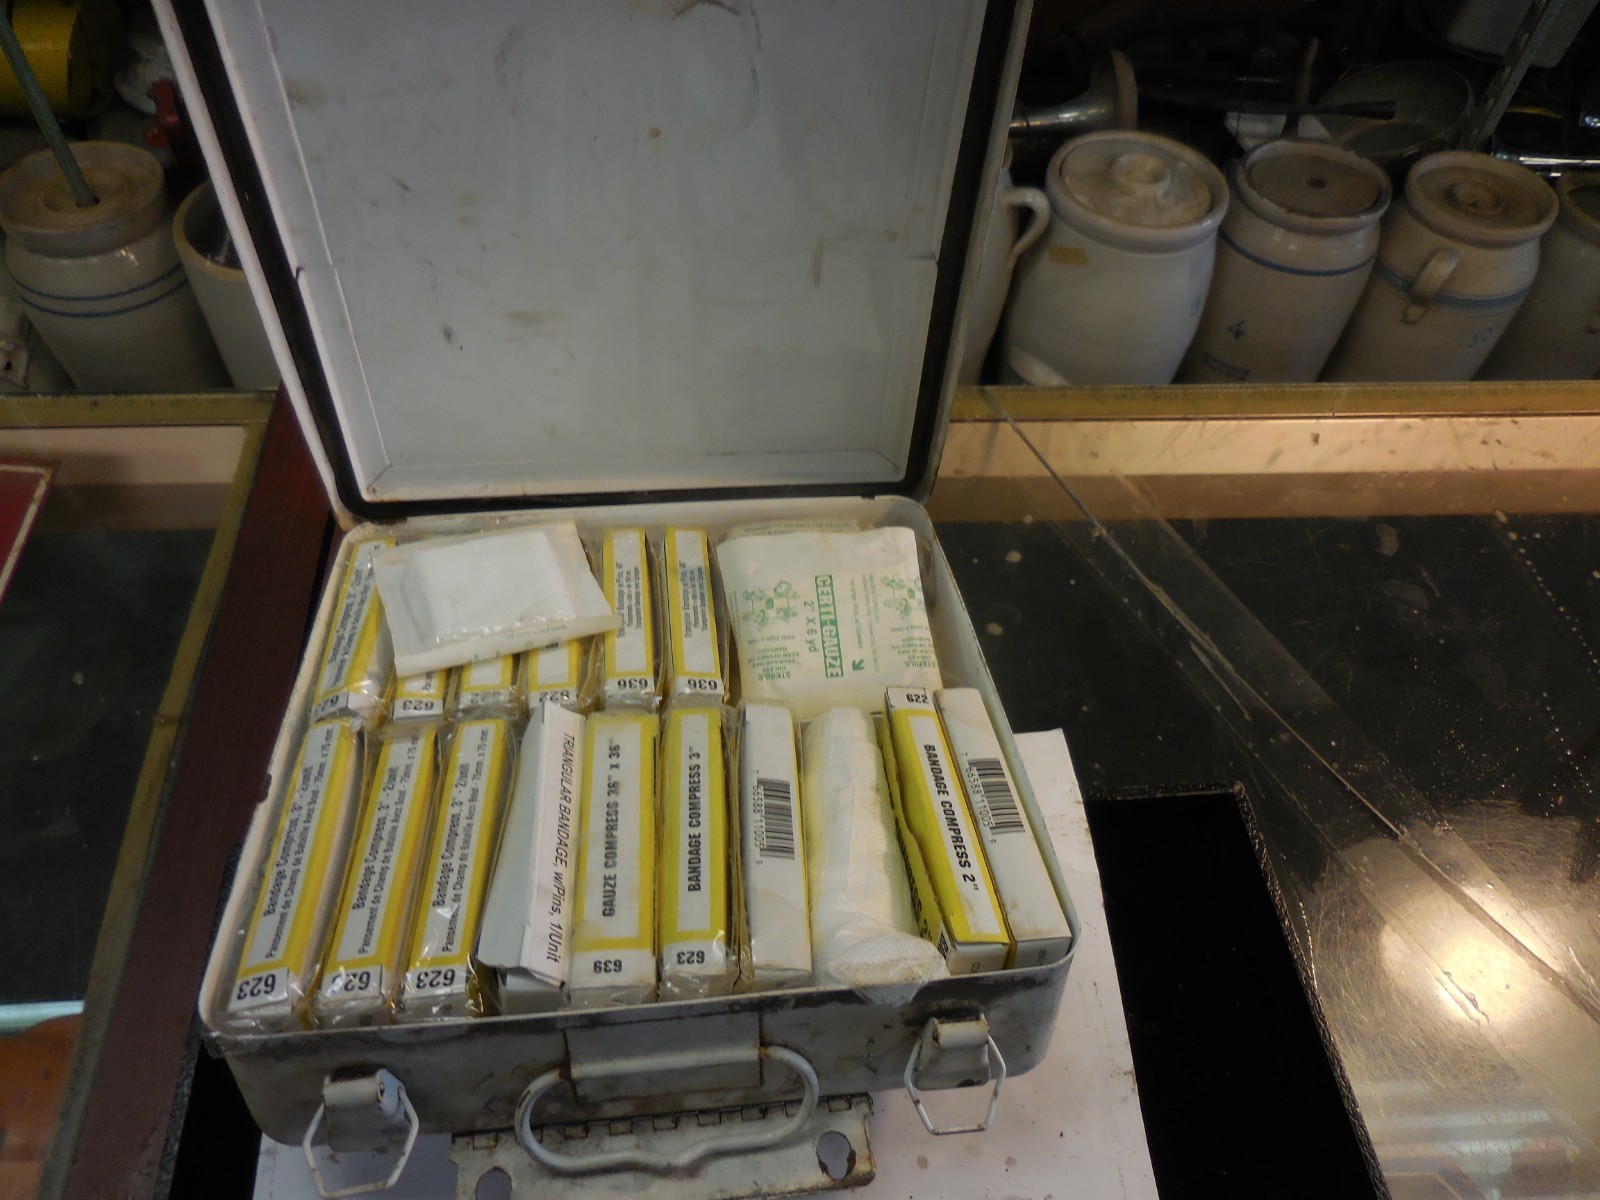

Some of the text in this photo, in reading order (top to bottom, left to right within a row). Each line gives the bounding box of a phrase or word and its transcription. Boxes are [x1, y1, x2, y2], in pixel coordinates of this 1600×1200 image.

[816, 576, 841, 676] CERTI-GAUZE
[805, 638, 818, 652] yd
[617, 678, 648, 689] 636
[688, 679, 717, 690] 636
[402, 699, 434, 711] 623
[906, 692, 928, 704] 622
[688, 763, 700, 827] COMPRESS
[922, 743, 950, 796] BANDAGE
[939, 799, 973, 869] COMPRESS
[604, 799, 619, 867] COMPRESS
[546, 732, 575, 964] TRIANGULAR BANDAGE, w/Pins, 1/Unit
[688, 833, 700, 890] BANDAGE
[602, 872, 616, 917] GAUZE
[593, 960, 622, 973] 639
[677, 951, 705, 965] 623
[237, 973, 276, 1000] 623
[416, 968, 455, 988] 623
